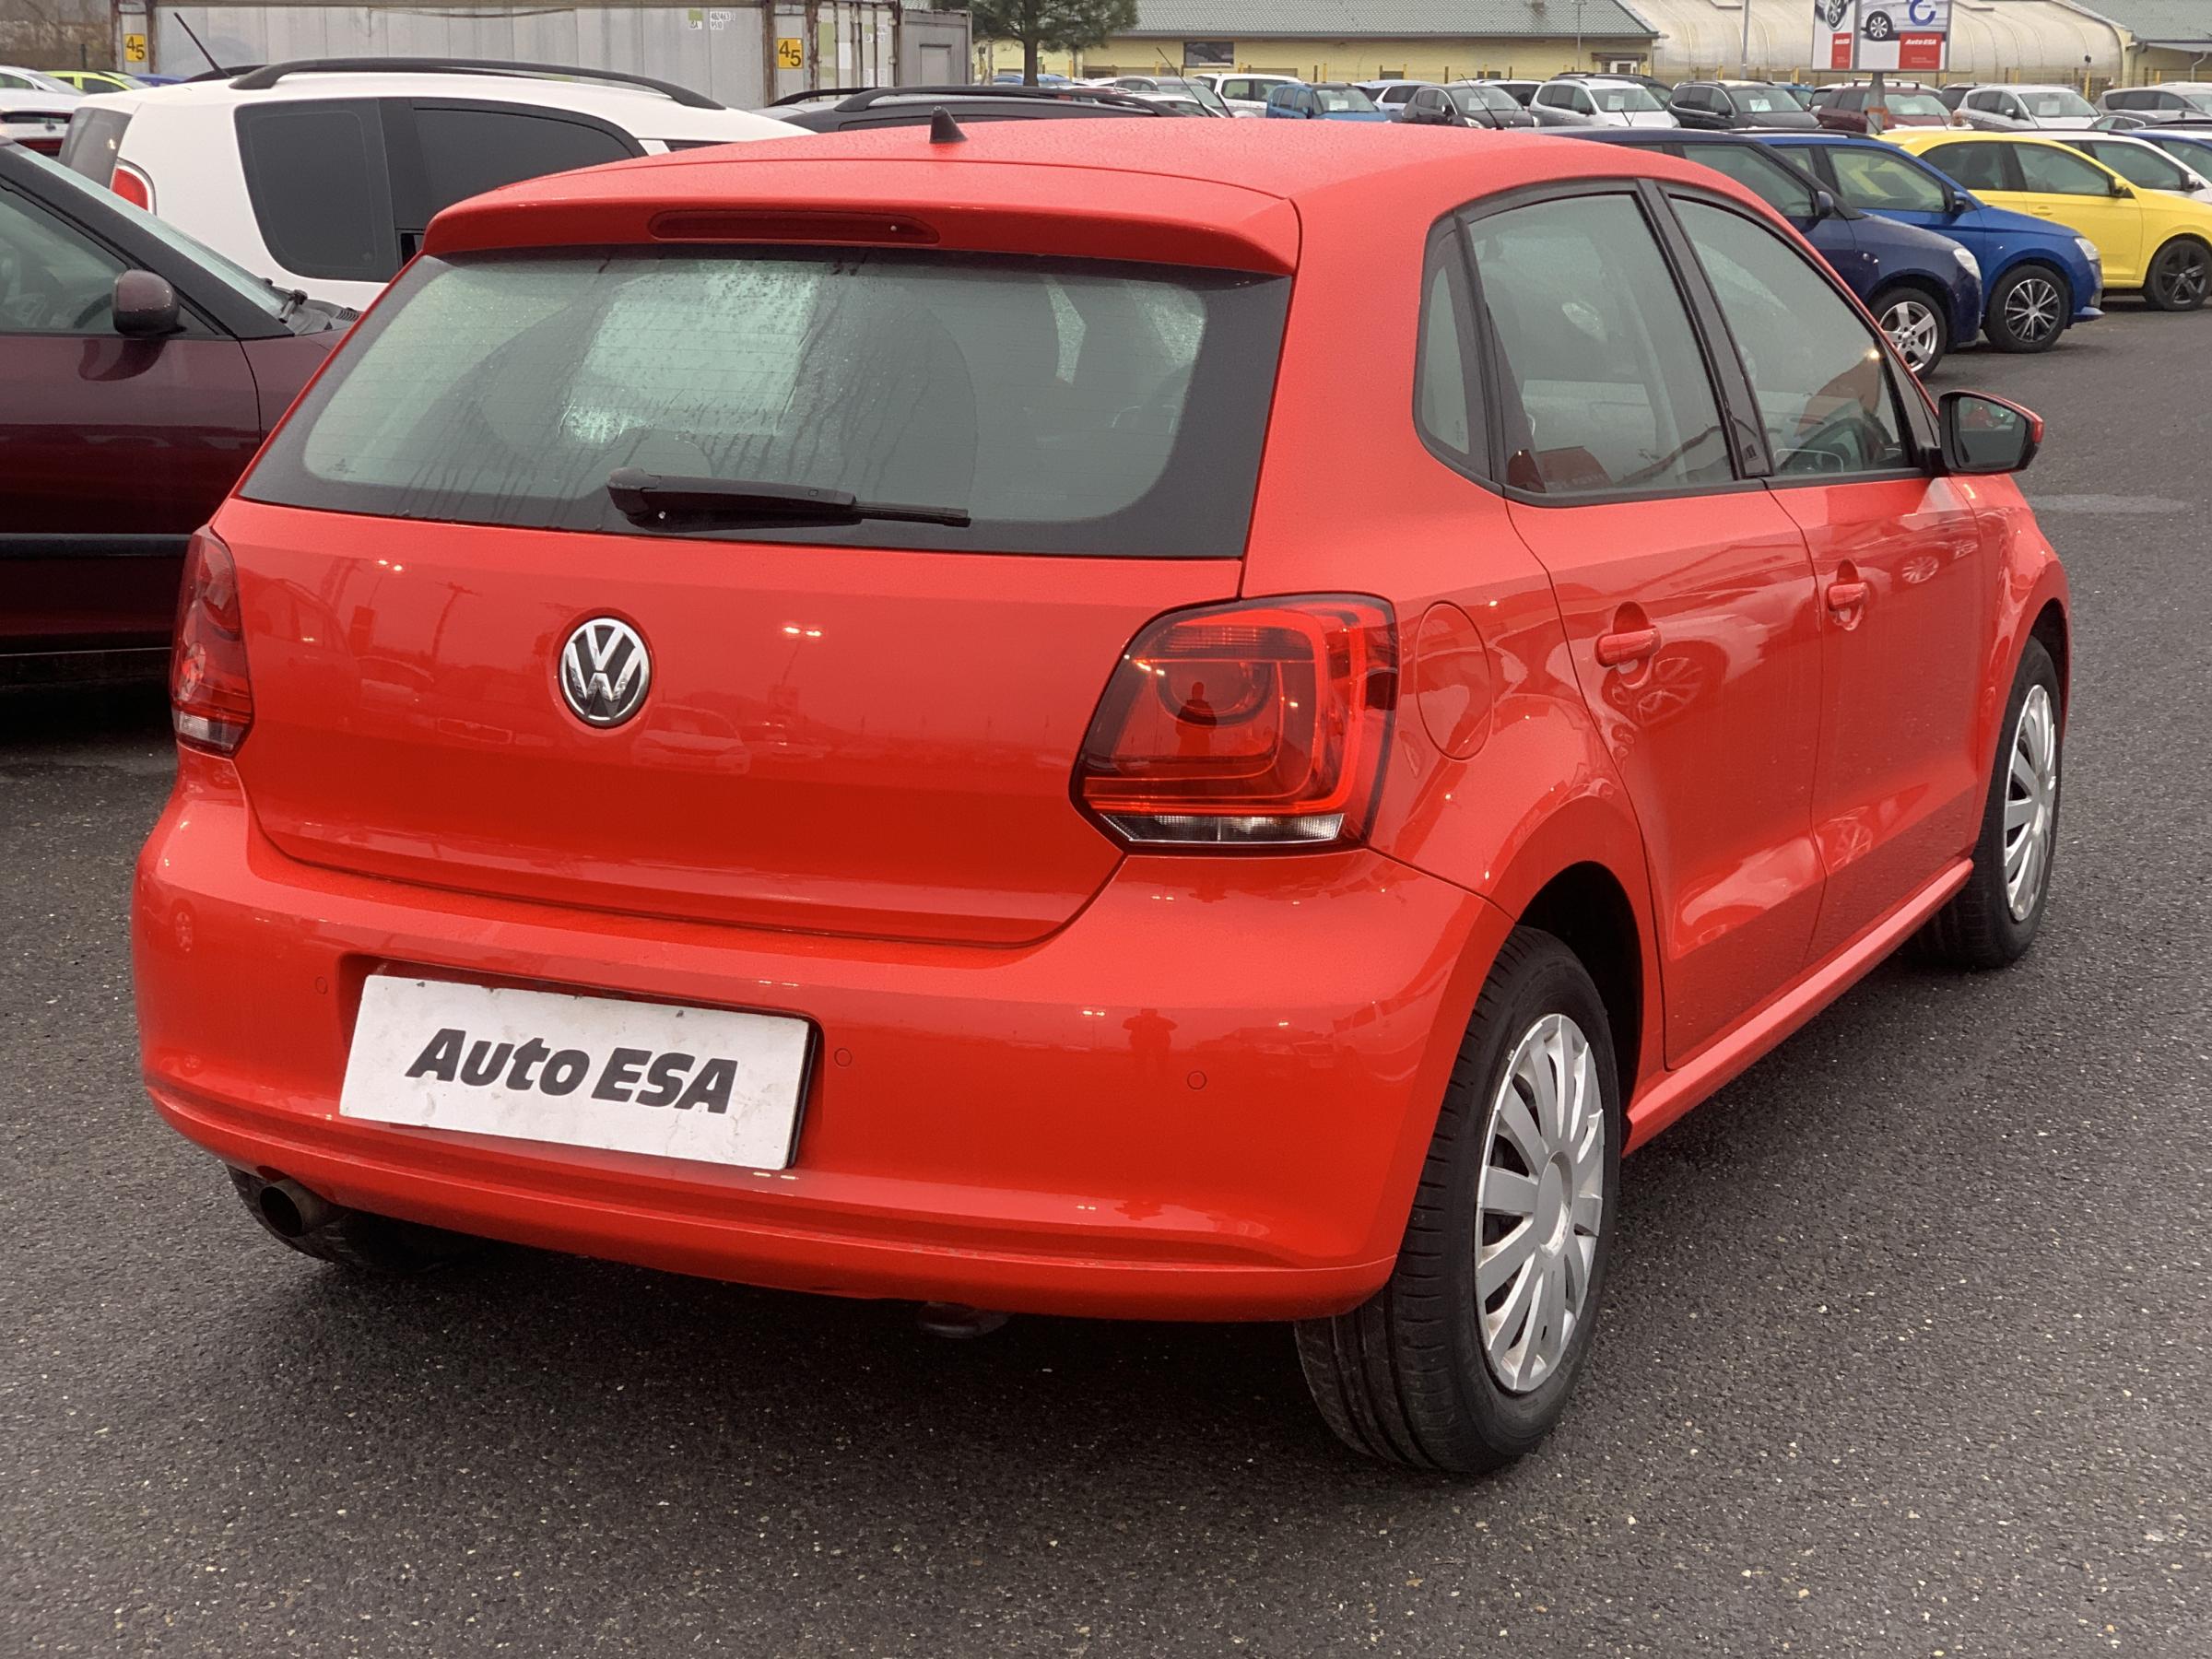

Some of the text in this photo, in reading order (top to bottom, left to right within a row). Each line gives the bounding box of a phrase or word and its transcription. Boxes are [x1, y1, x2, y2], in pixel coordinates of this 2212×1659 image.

[126, 35, 146, 61] 45
[779, 40, 802, 67] 45
[405, 1028, 738, 1114] Auto ESA
